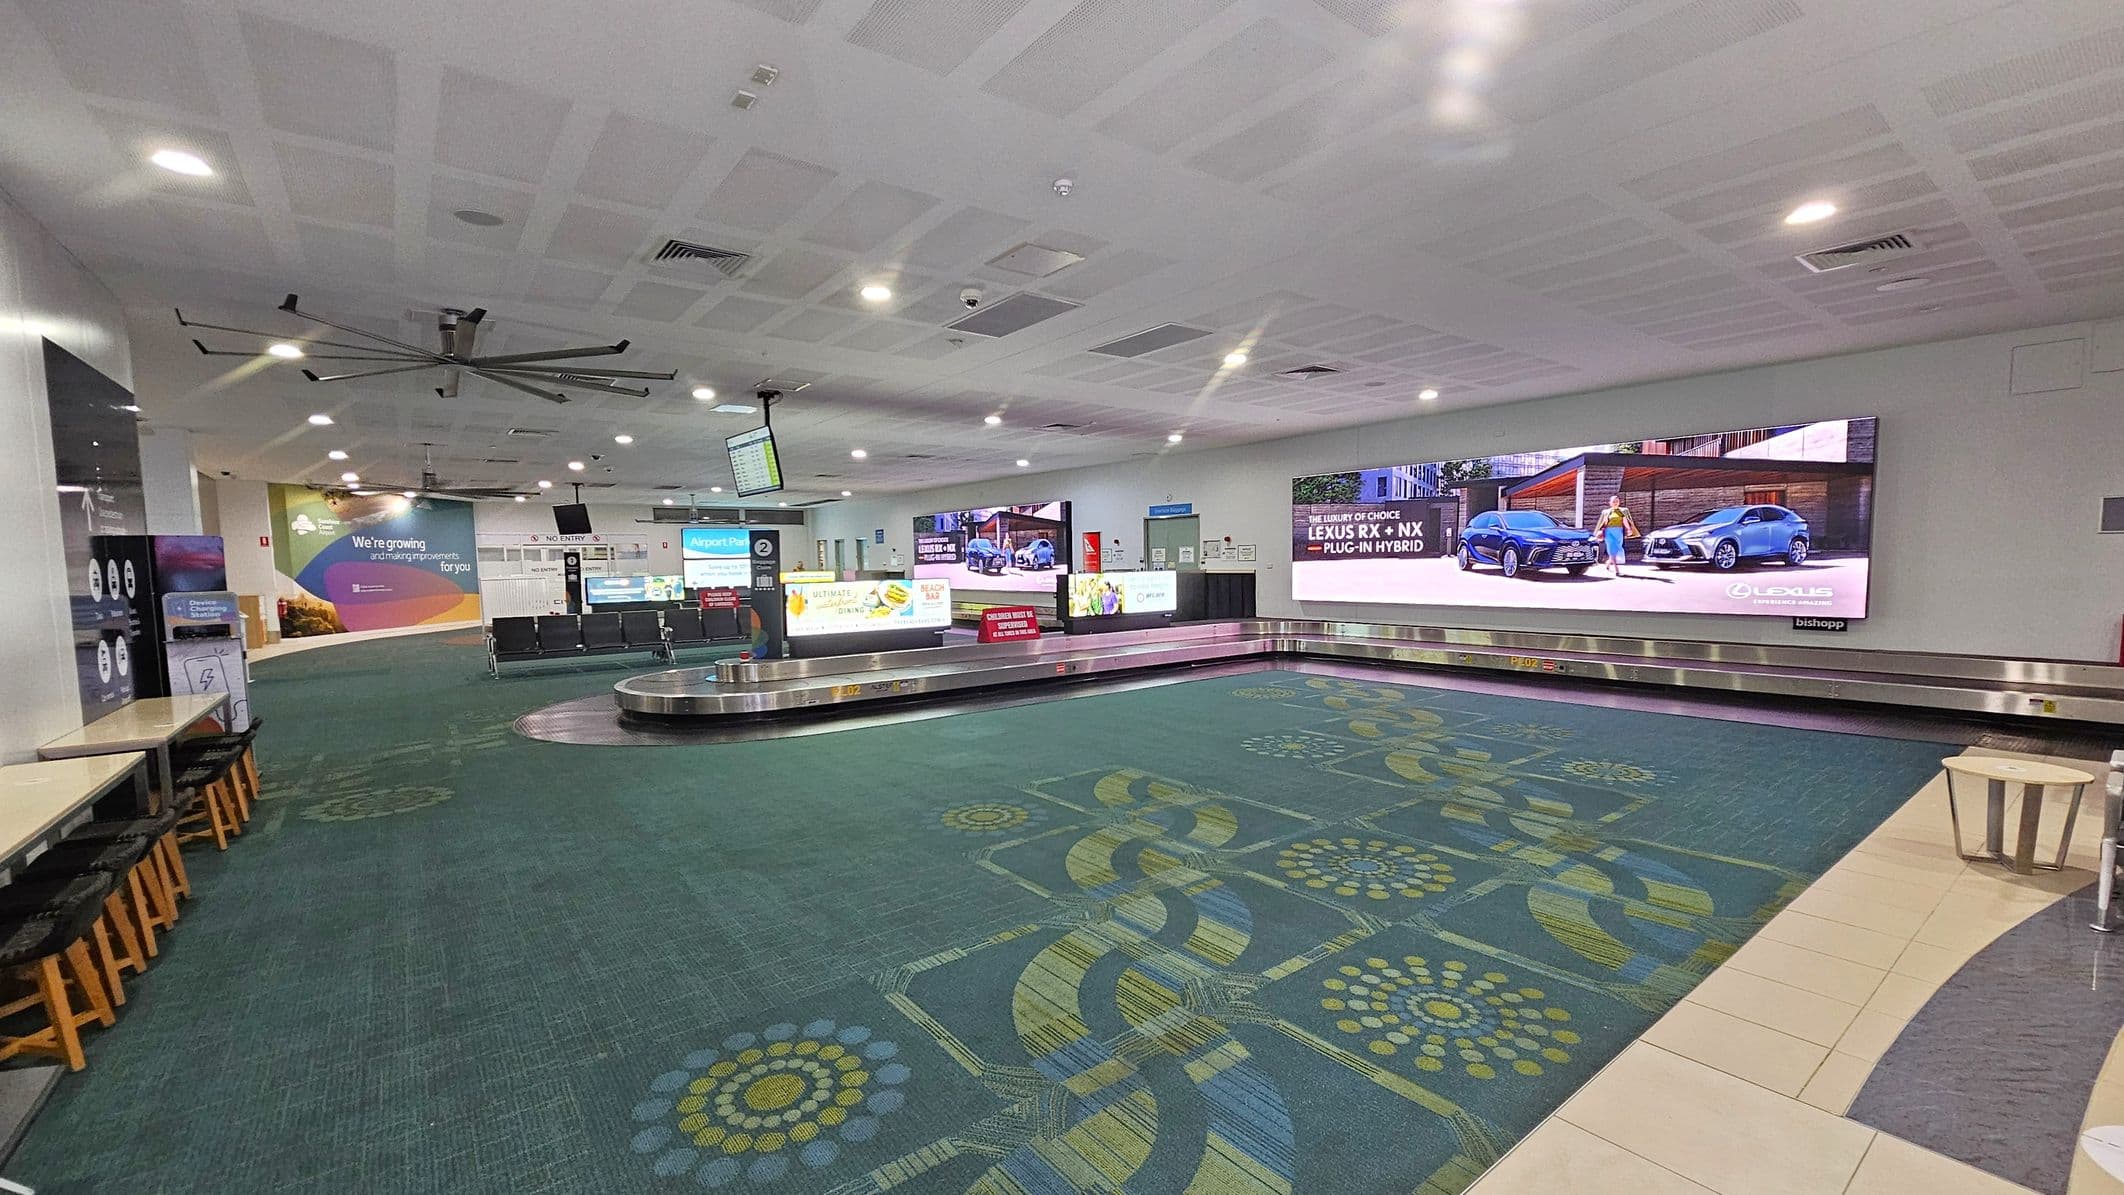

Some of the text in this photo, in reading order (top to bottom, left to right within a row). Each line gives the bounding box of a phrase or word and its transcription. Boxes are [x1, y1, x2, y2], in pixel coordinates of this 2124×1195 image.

[1309, 510, 1400, 524] THE LUXURY OF CHOICE
[1308, 521, 1423, 540] LEXUS RX + NX
[352, 536, 426, 551] We're growing
[691, 536, 726, 548] Airport
[760, 542, 768, 553] 2
[1324, 540, 1423, 554] PLUG-IN HYBRID
[370, 552, 460, 562] and making improvements
[440, 561, 470, 574] for you
[920, 584, 944, 592] BEACH
[1753, 587, 1833, 596] LEXUS
[813, 590, 851, 598] ULTIMATE
[926, 592, 940, 600] BAR
[986, 612, 1012, 620] CHILDREN
[997, 621, 1028, 630] SUPERVISED
[1796, 618, 1844, 630] bishopp
